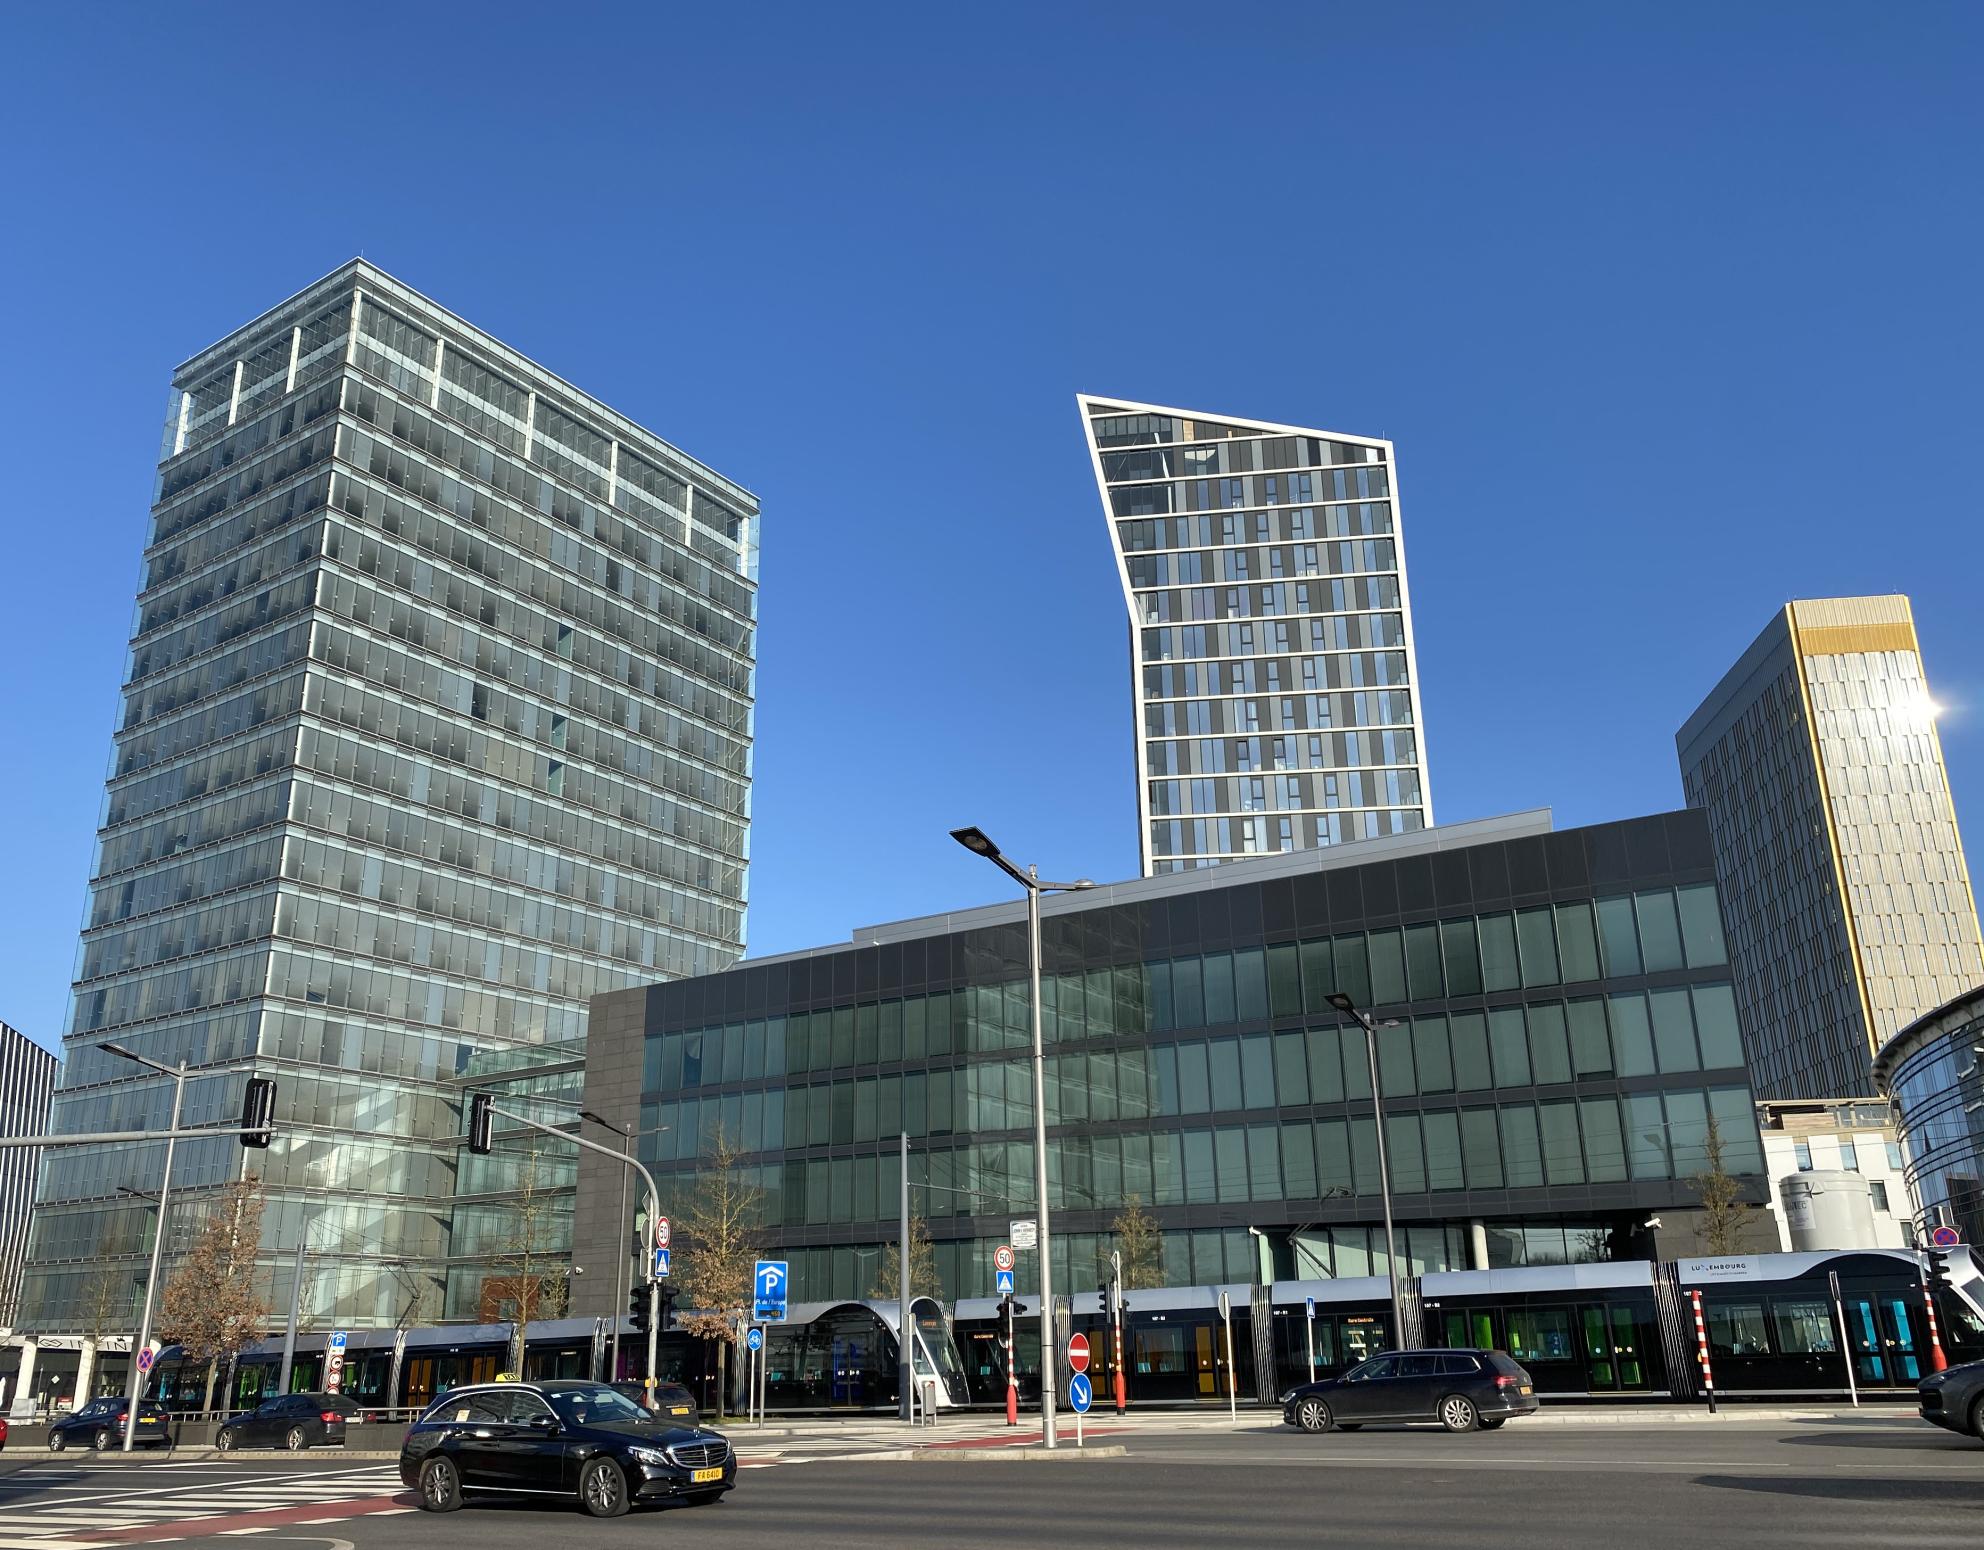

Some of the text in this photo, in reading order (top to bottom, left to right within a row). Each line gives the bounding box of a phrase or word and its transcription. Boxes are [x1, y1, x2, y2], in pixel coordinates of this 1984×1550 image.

[660, 1226, 667, 1239] 50
[999, 1253, 1010, 1264] 50
[766, 1274, 778, 1295] P
[336, 1336, 343, 1346] P
